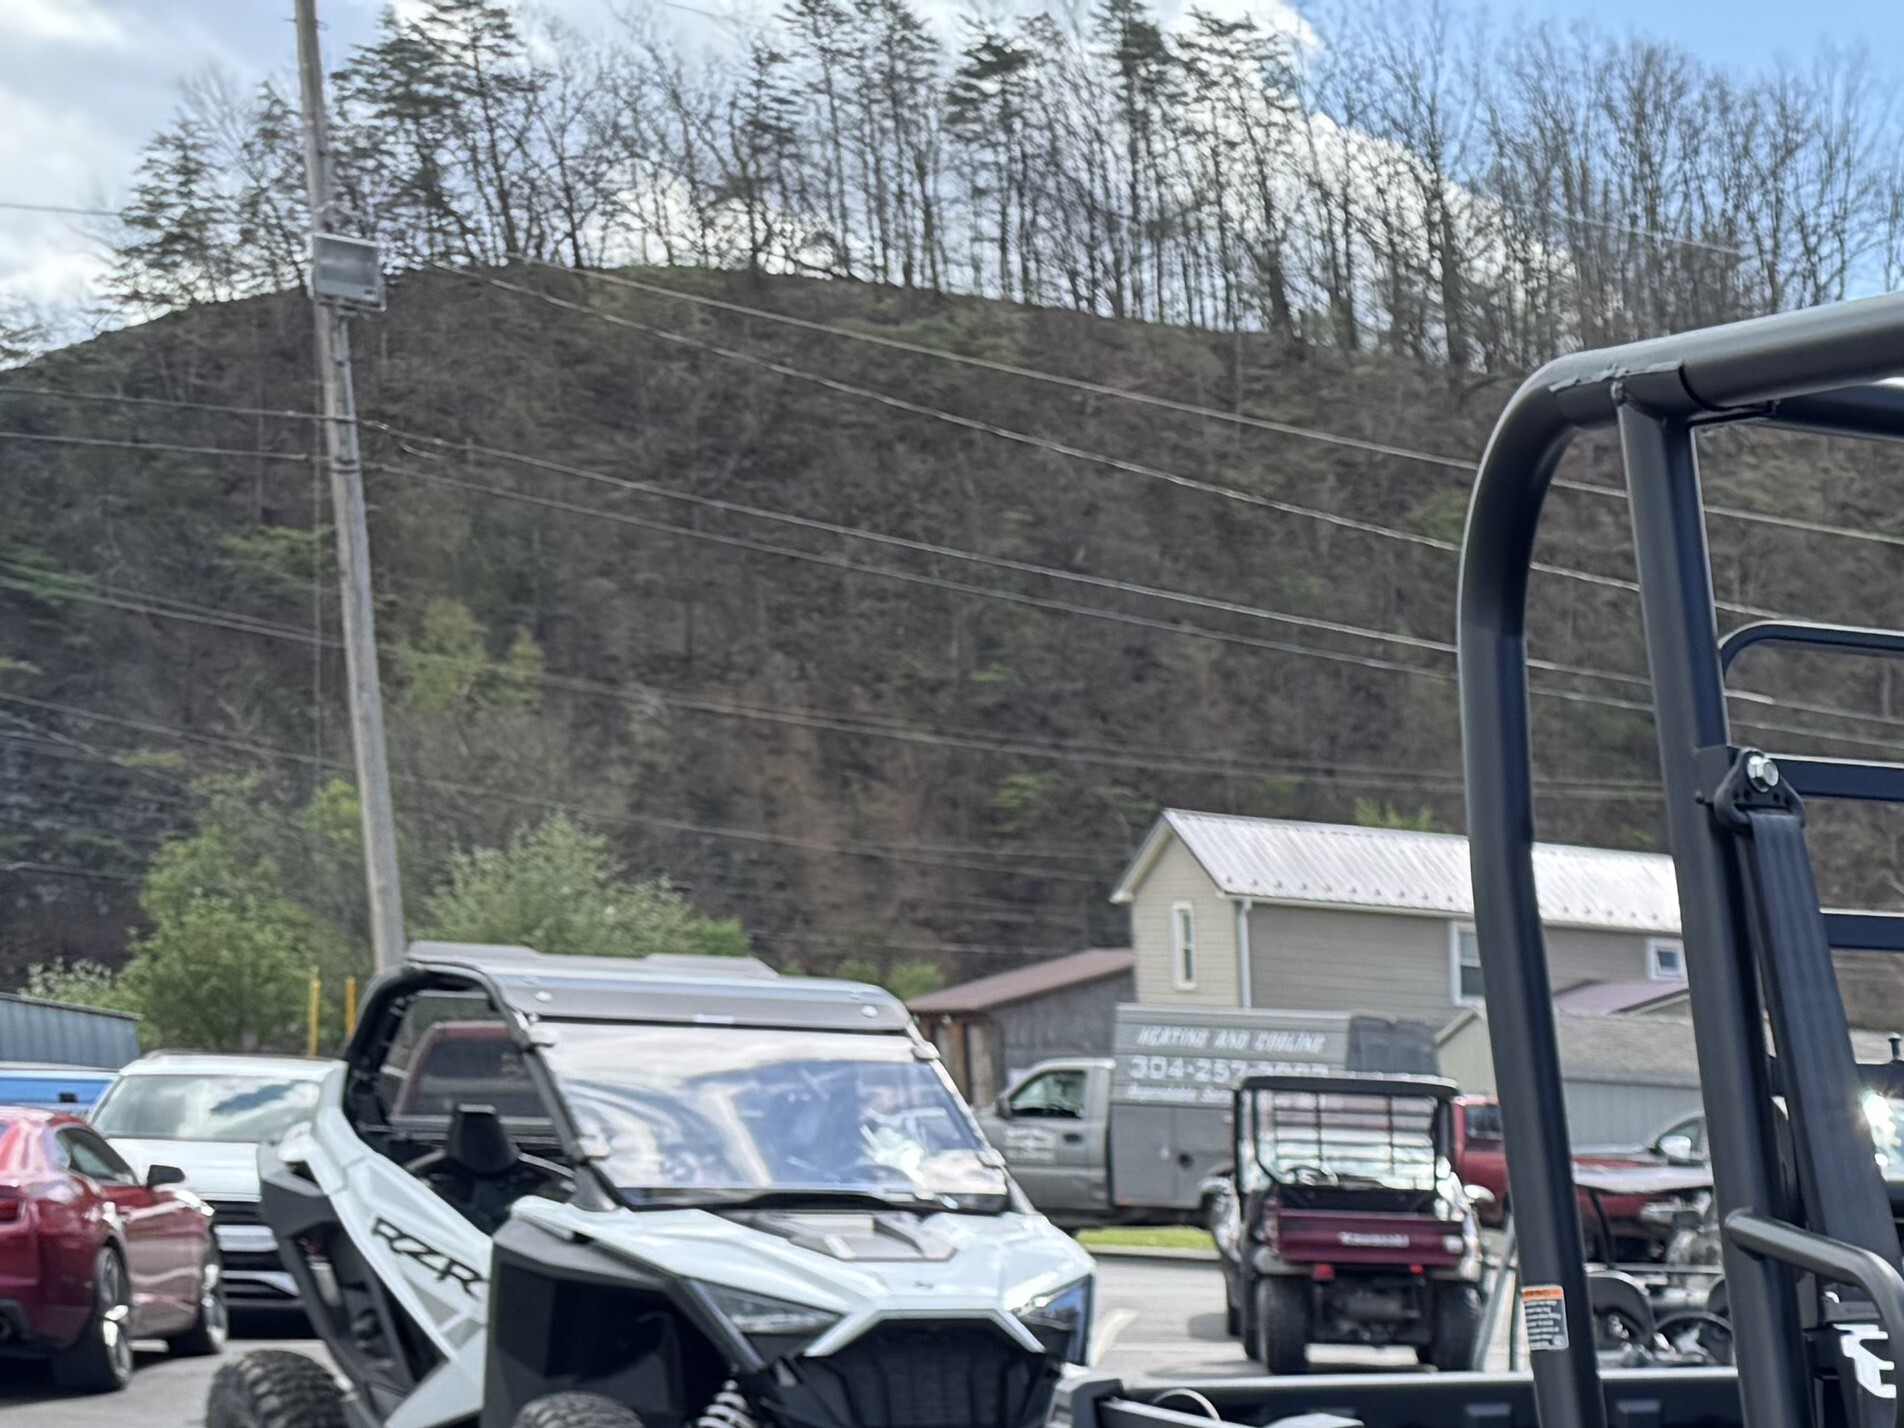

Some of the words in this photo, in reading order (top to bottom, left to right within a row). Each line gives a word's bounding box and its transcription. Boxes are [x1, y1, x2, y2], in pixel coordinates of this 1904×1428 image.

[1137, 1025, 1210, 1048] HEATING
[1213, 1029, 1250, 1050] AND
[1254, 1031, 1326, 1053] COOLING
[370, 1216, 489, 1302] RZR
